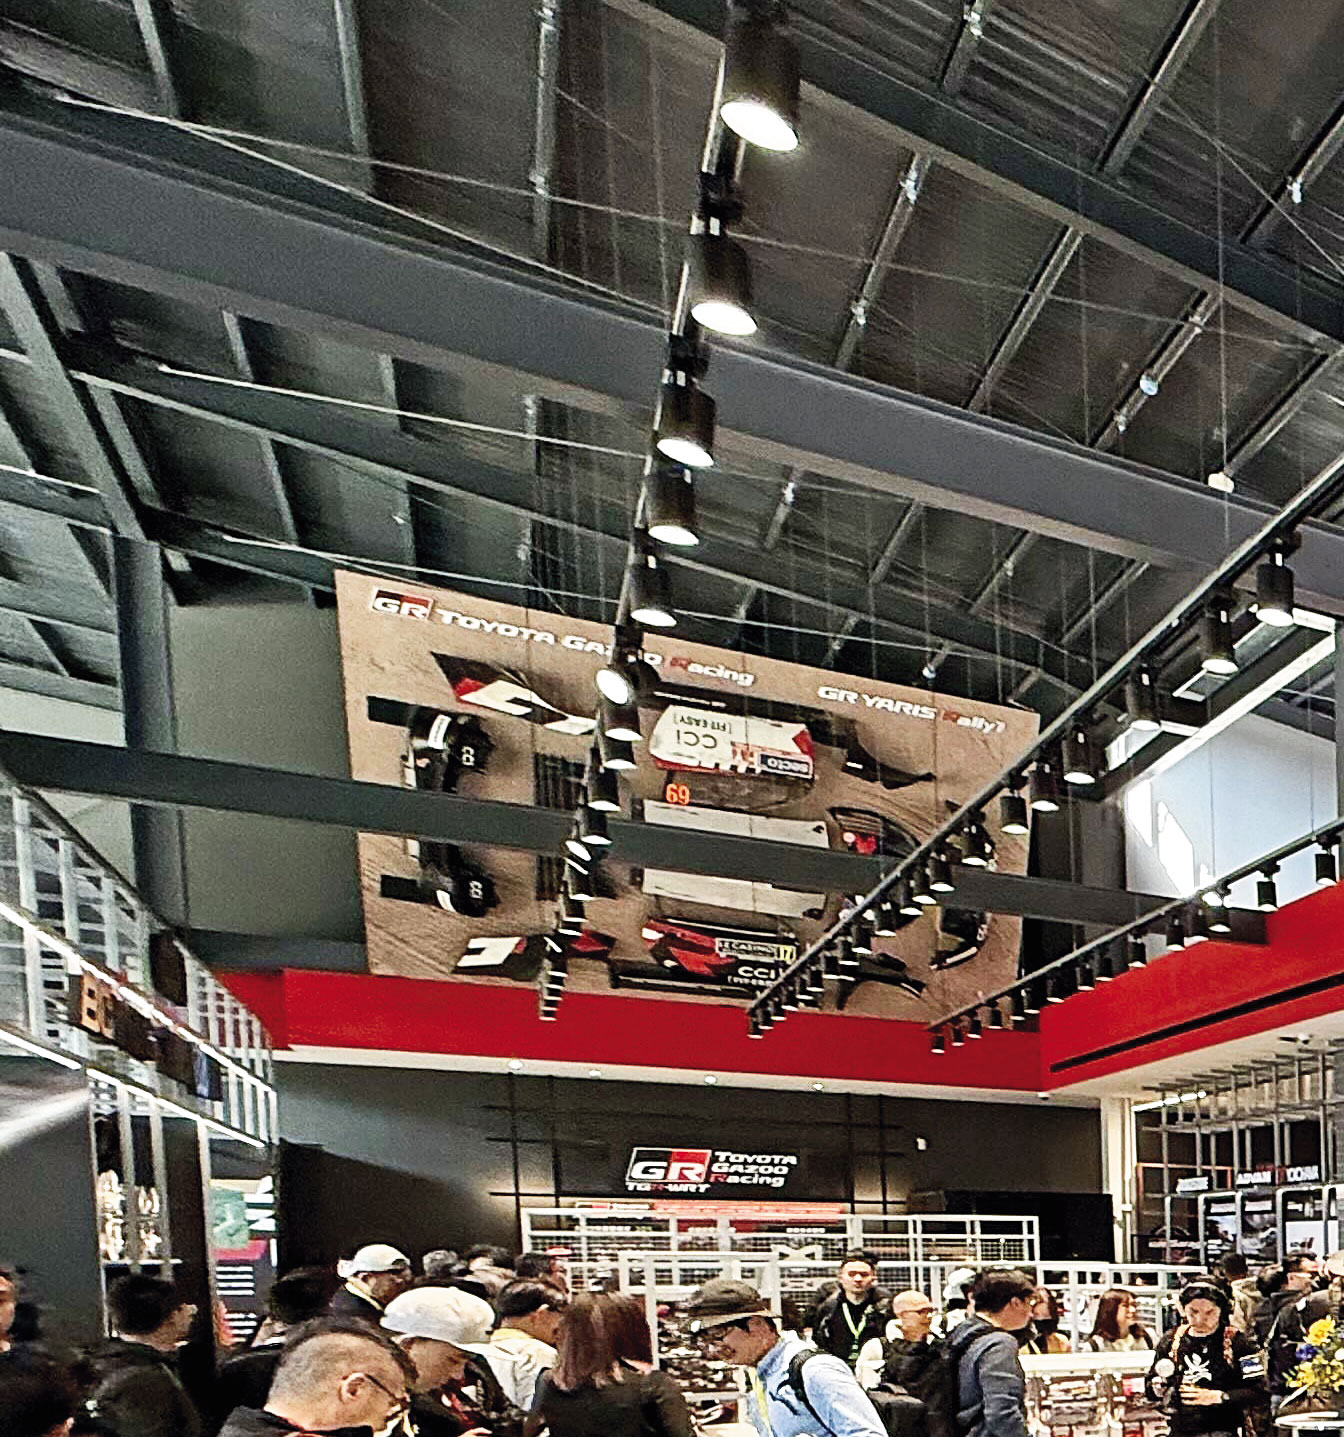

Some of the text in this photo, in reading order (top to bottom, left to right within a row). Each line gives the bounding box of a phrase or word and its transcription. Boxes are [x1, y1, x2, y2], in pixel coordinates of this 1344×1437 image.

[373, 597, 755, 687] GR TOYOTA GAO Racing
[817, 686, 858, 704] GR
[862, 692, 938, 719] YARIS
[665, 783, 691, 806] 69
[631, 1151, 798, 1181] GR TOYOTA
[711, 1163, 789, 1175] GAZOO
[709, 1174, 786, 1187] Racing
